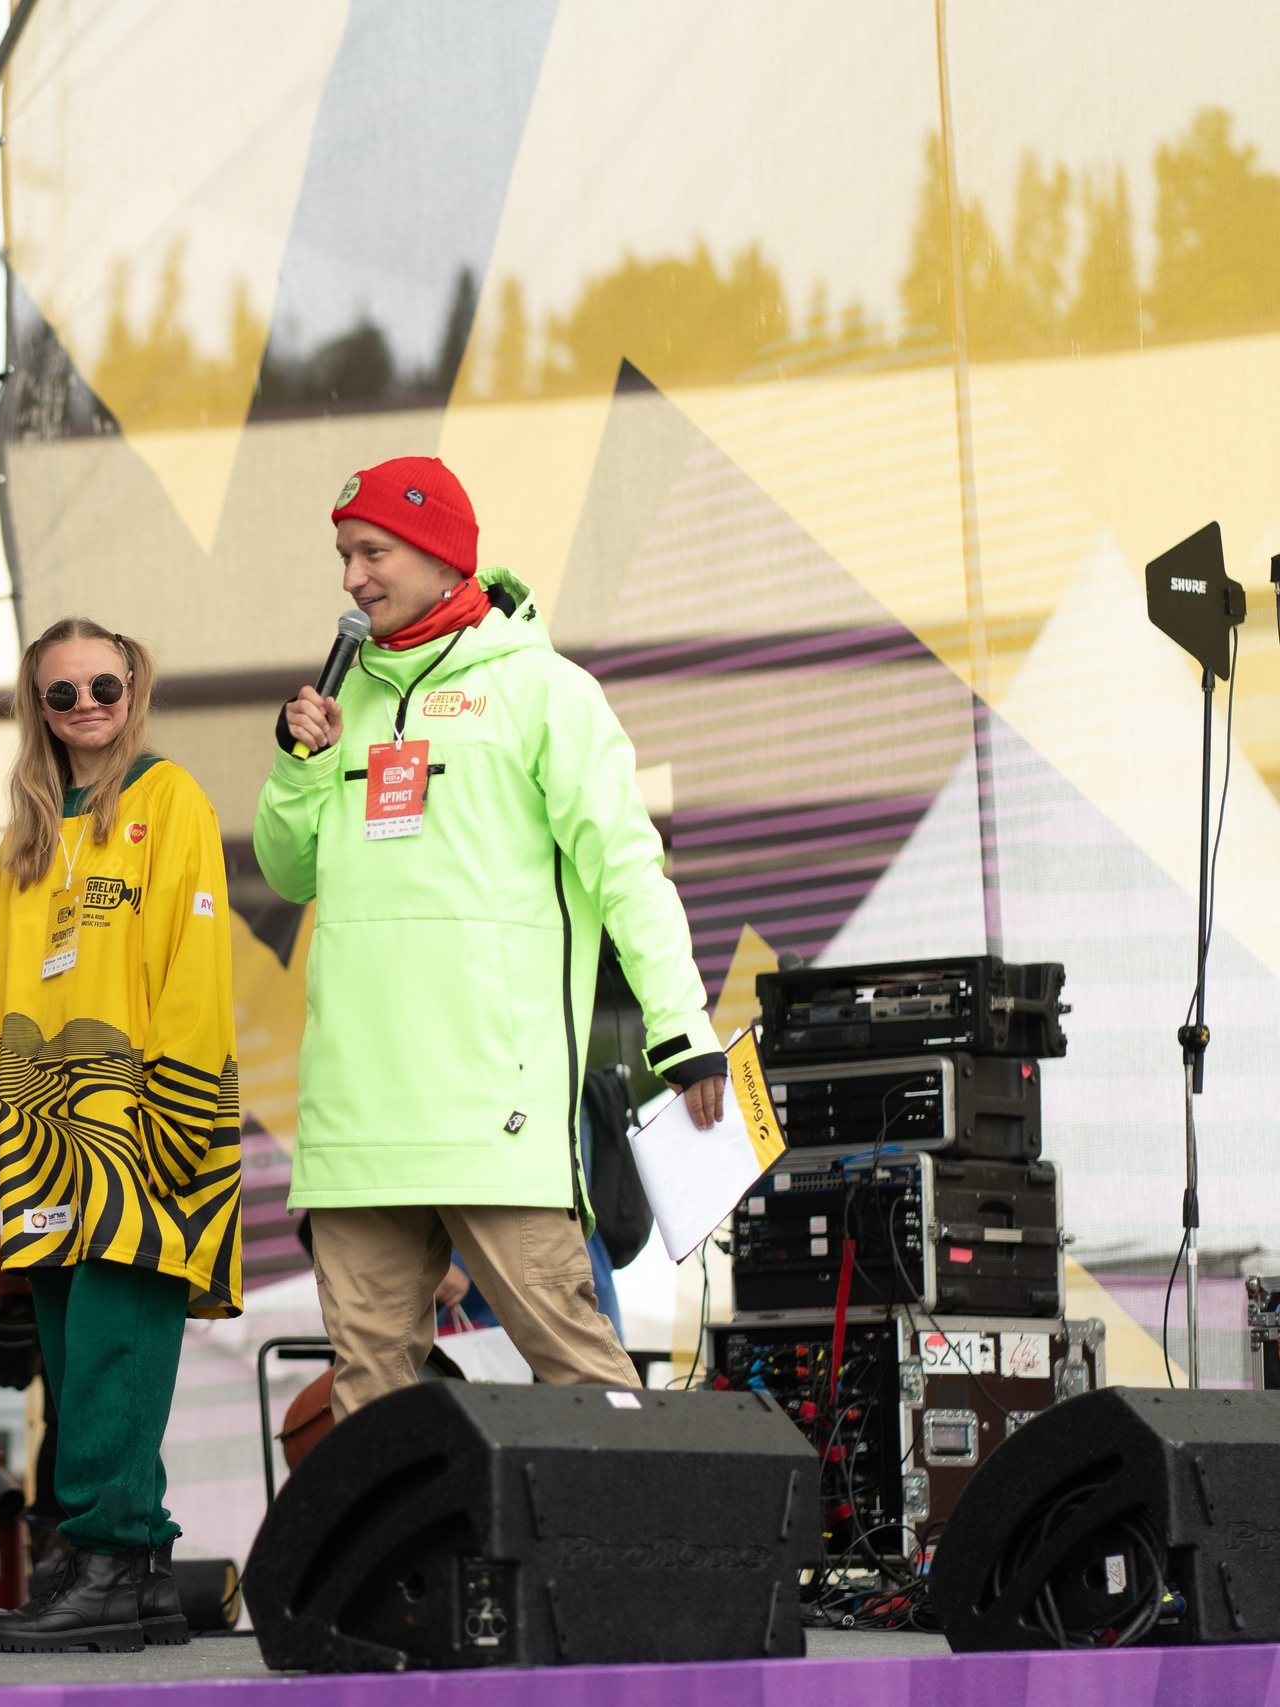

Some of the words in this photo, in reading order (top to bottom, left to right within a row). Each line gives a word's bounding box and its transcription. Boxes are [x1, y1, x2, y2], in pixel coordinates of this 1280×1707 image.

[1170, 577, 1207, 595] SHURE
[430, 693, 460, 703] GRELKA
[427, 704, 449, 714] FEST
[379, 789, 414, 804] АРТИСТ
[87, 881, 121, 894] GRELKA
[85, 893, 109, 905] FEST
[742, 1060, 764, 1122] билайн
